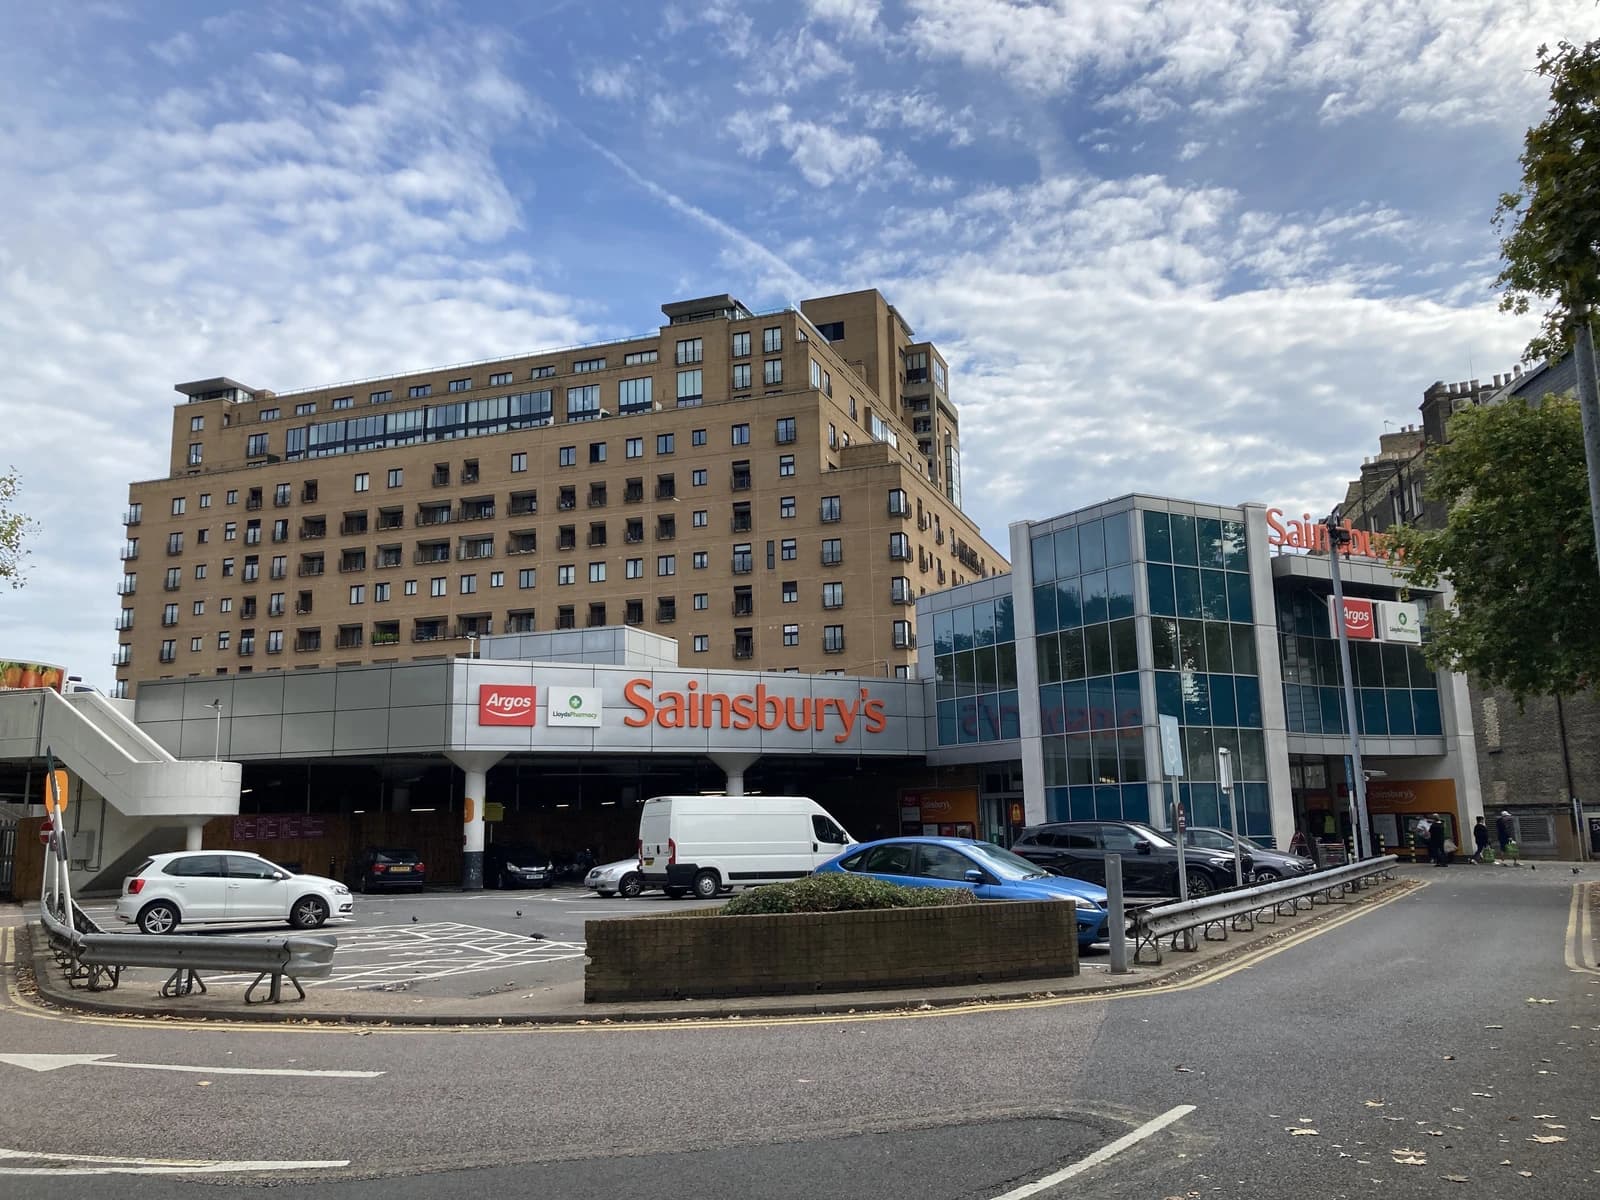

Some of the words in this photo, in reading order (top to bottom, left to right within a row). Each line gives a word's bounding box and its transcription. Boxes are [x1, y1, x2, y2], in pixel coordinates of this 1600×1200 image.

[485, 693, 532, 714] Argos
[623, 678, 887, 744] Sainsbury's
[552, 709, 598, 720] LloydsPharmacy
